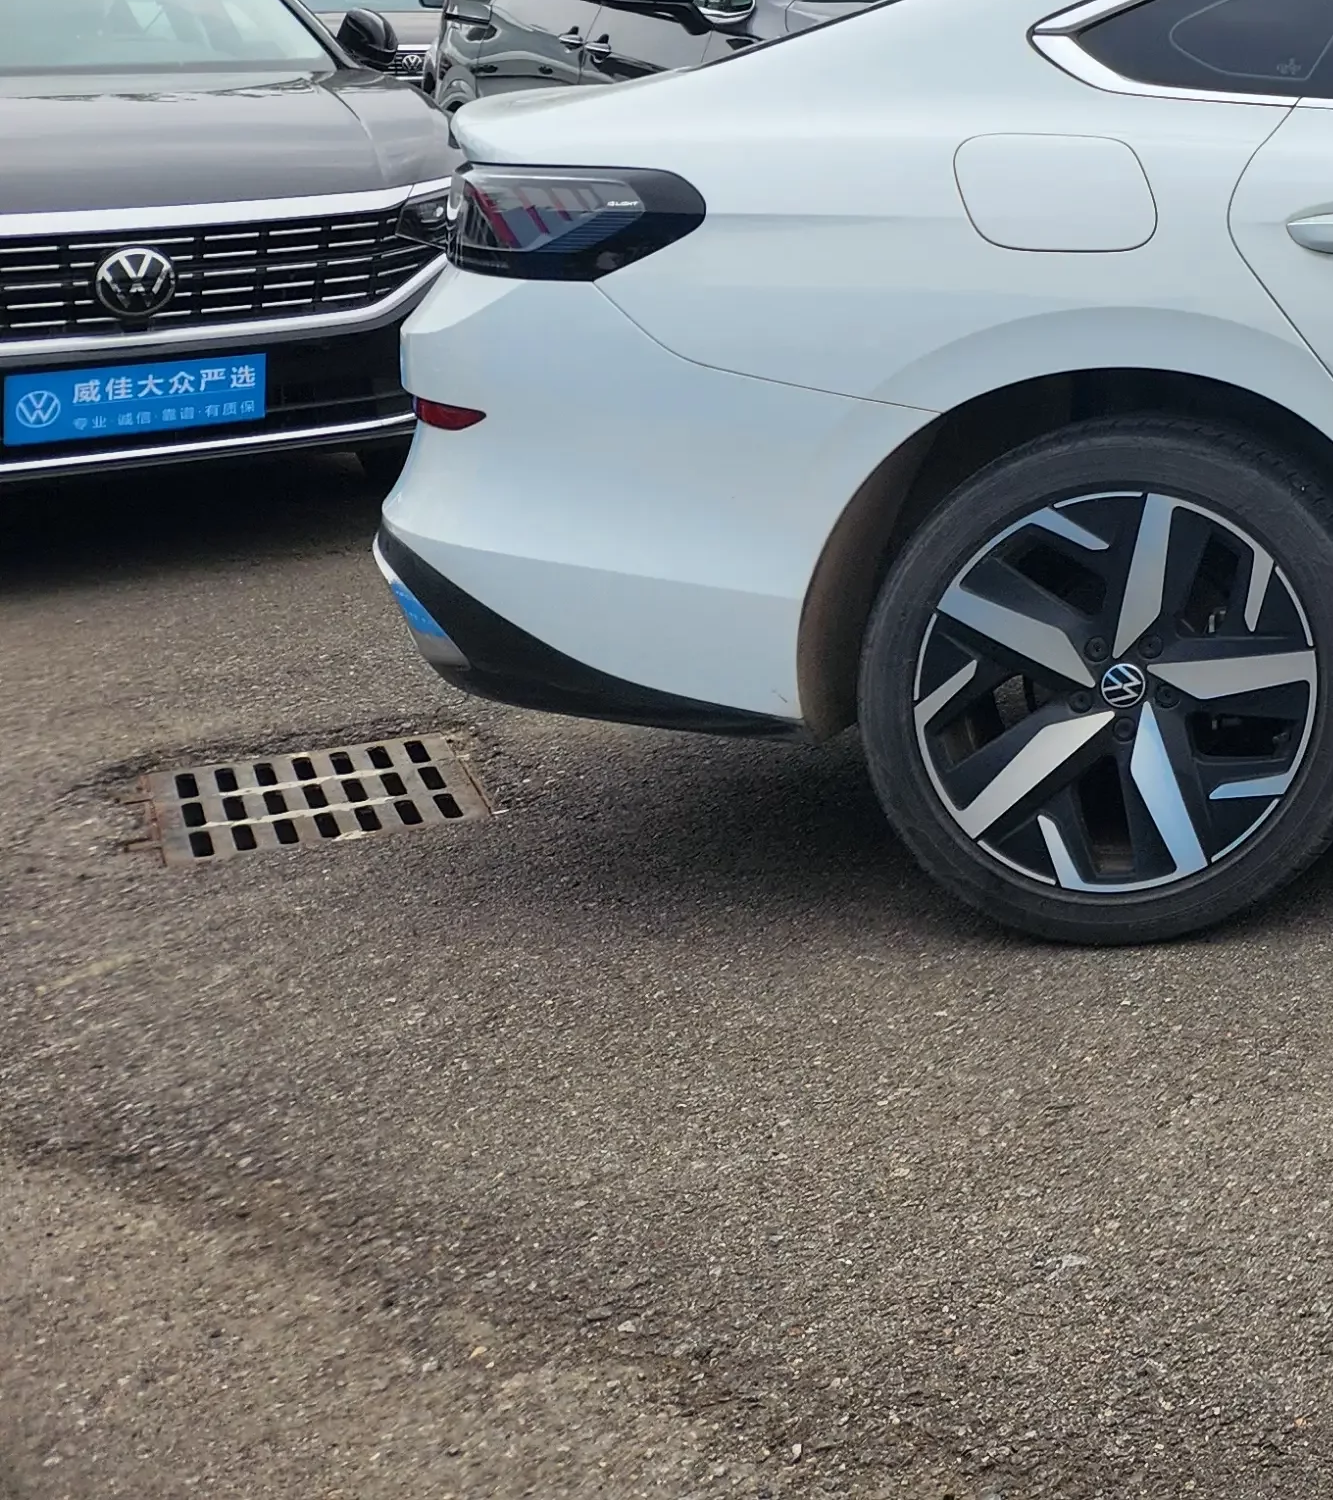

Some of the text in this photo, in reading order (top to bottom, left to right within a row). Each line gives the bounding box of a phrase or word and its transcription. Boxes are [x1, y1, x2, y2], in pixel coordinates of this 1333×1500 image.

[71, 364, 257, 404] 威佳大众严选
